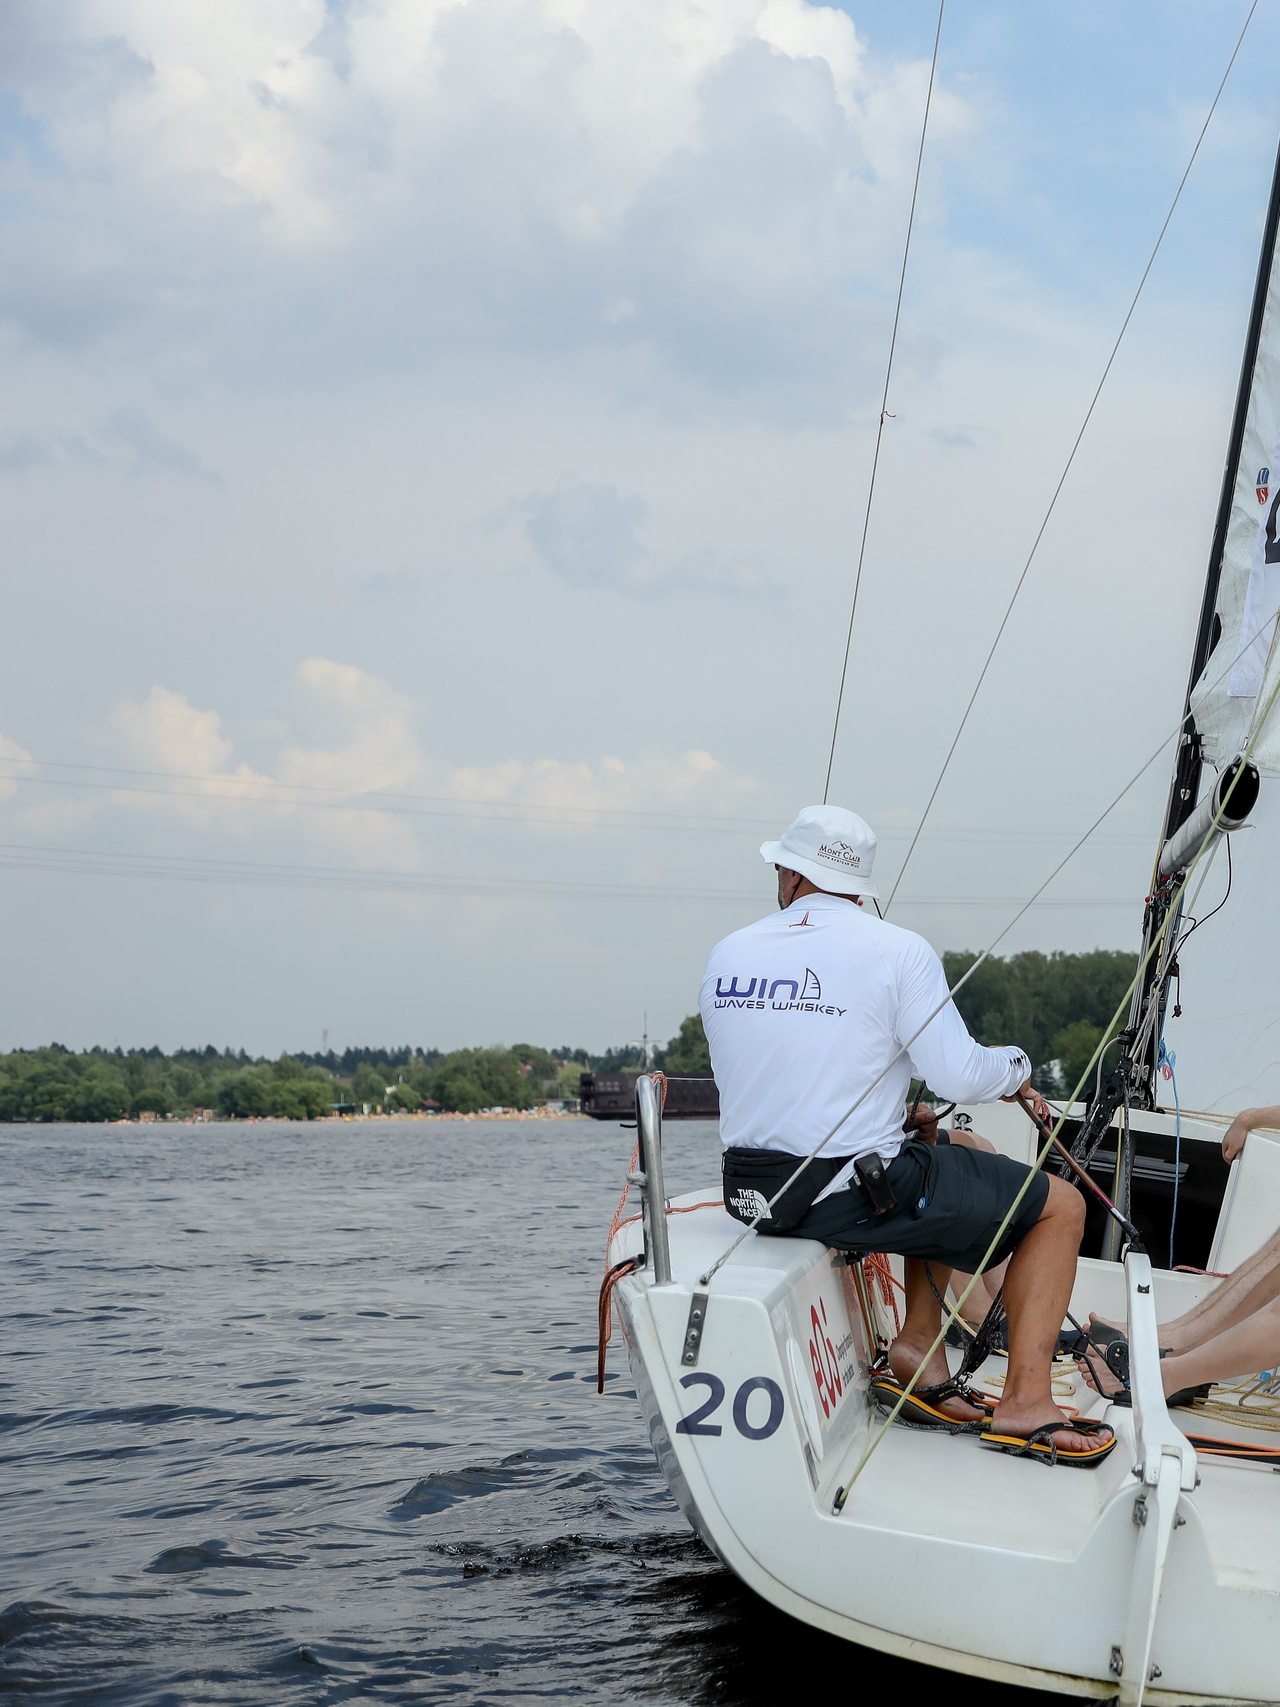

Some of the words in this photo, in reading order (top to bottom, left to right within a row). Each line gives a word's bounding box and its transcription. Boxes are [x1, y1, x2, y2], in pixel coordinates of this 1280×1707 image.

[819, 843, 841, 857] MONT
[714, 999, 766, 1010] WAVES
[771, 1001, 848, 1017] WHISKEY
[737, 1188, 754, 1199] THE
[729, 1197, 757, 1209] NORTH
[738, 1207, 759, 1218] FACE
[675, 1371, 785, 1441] 20
